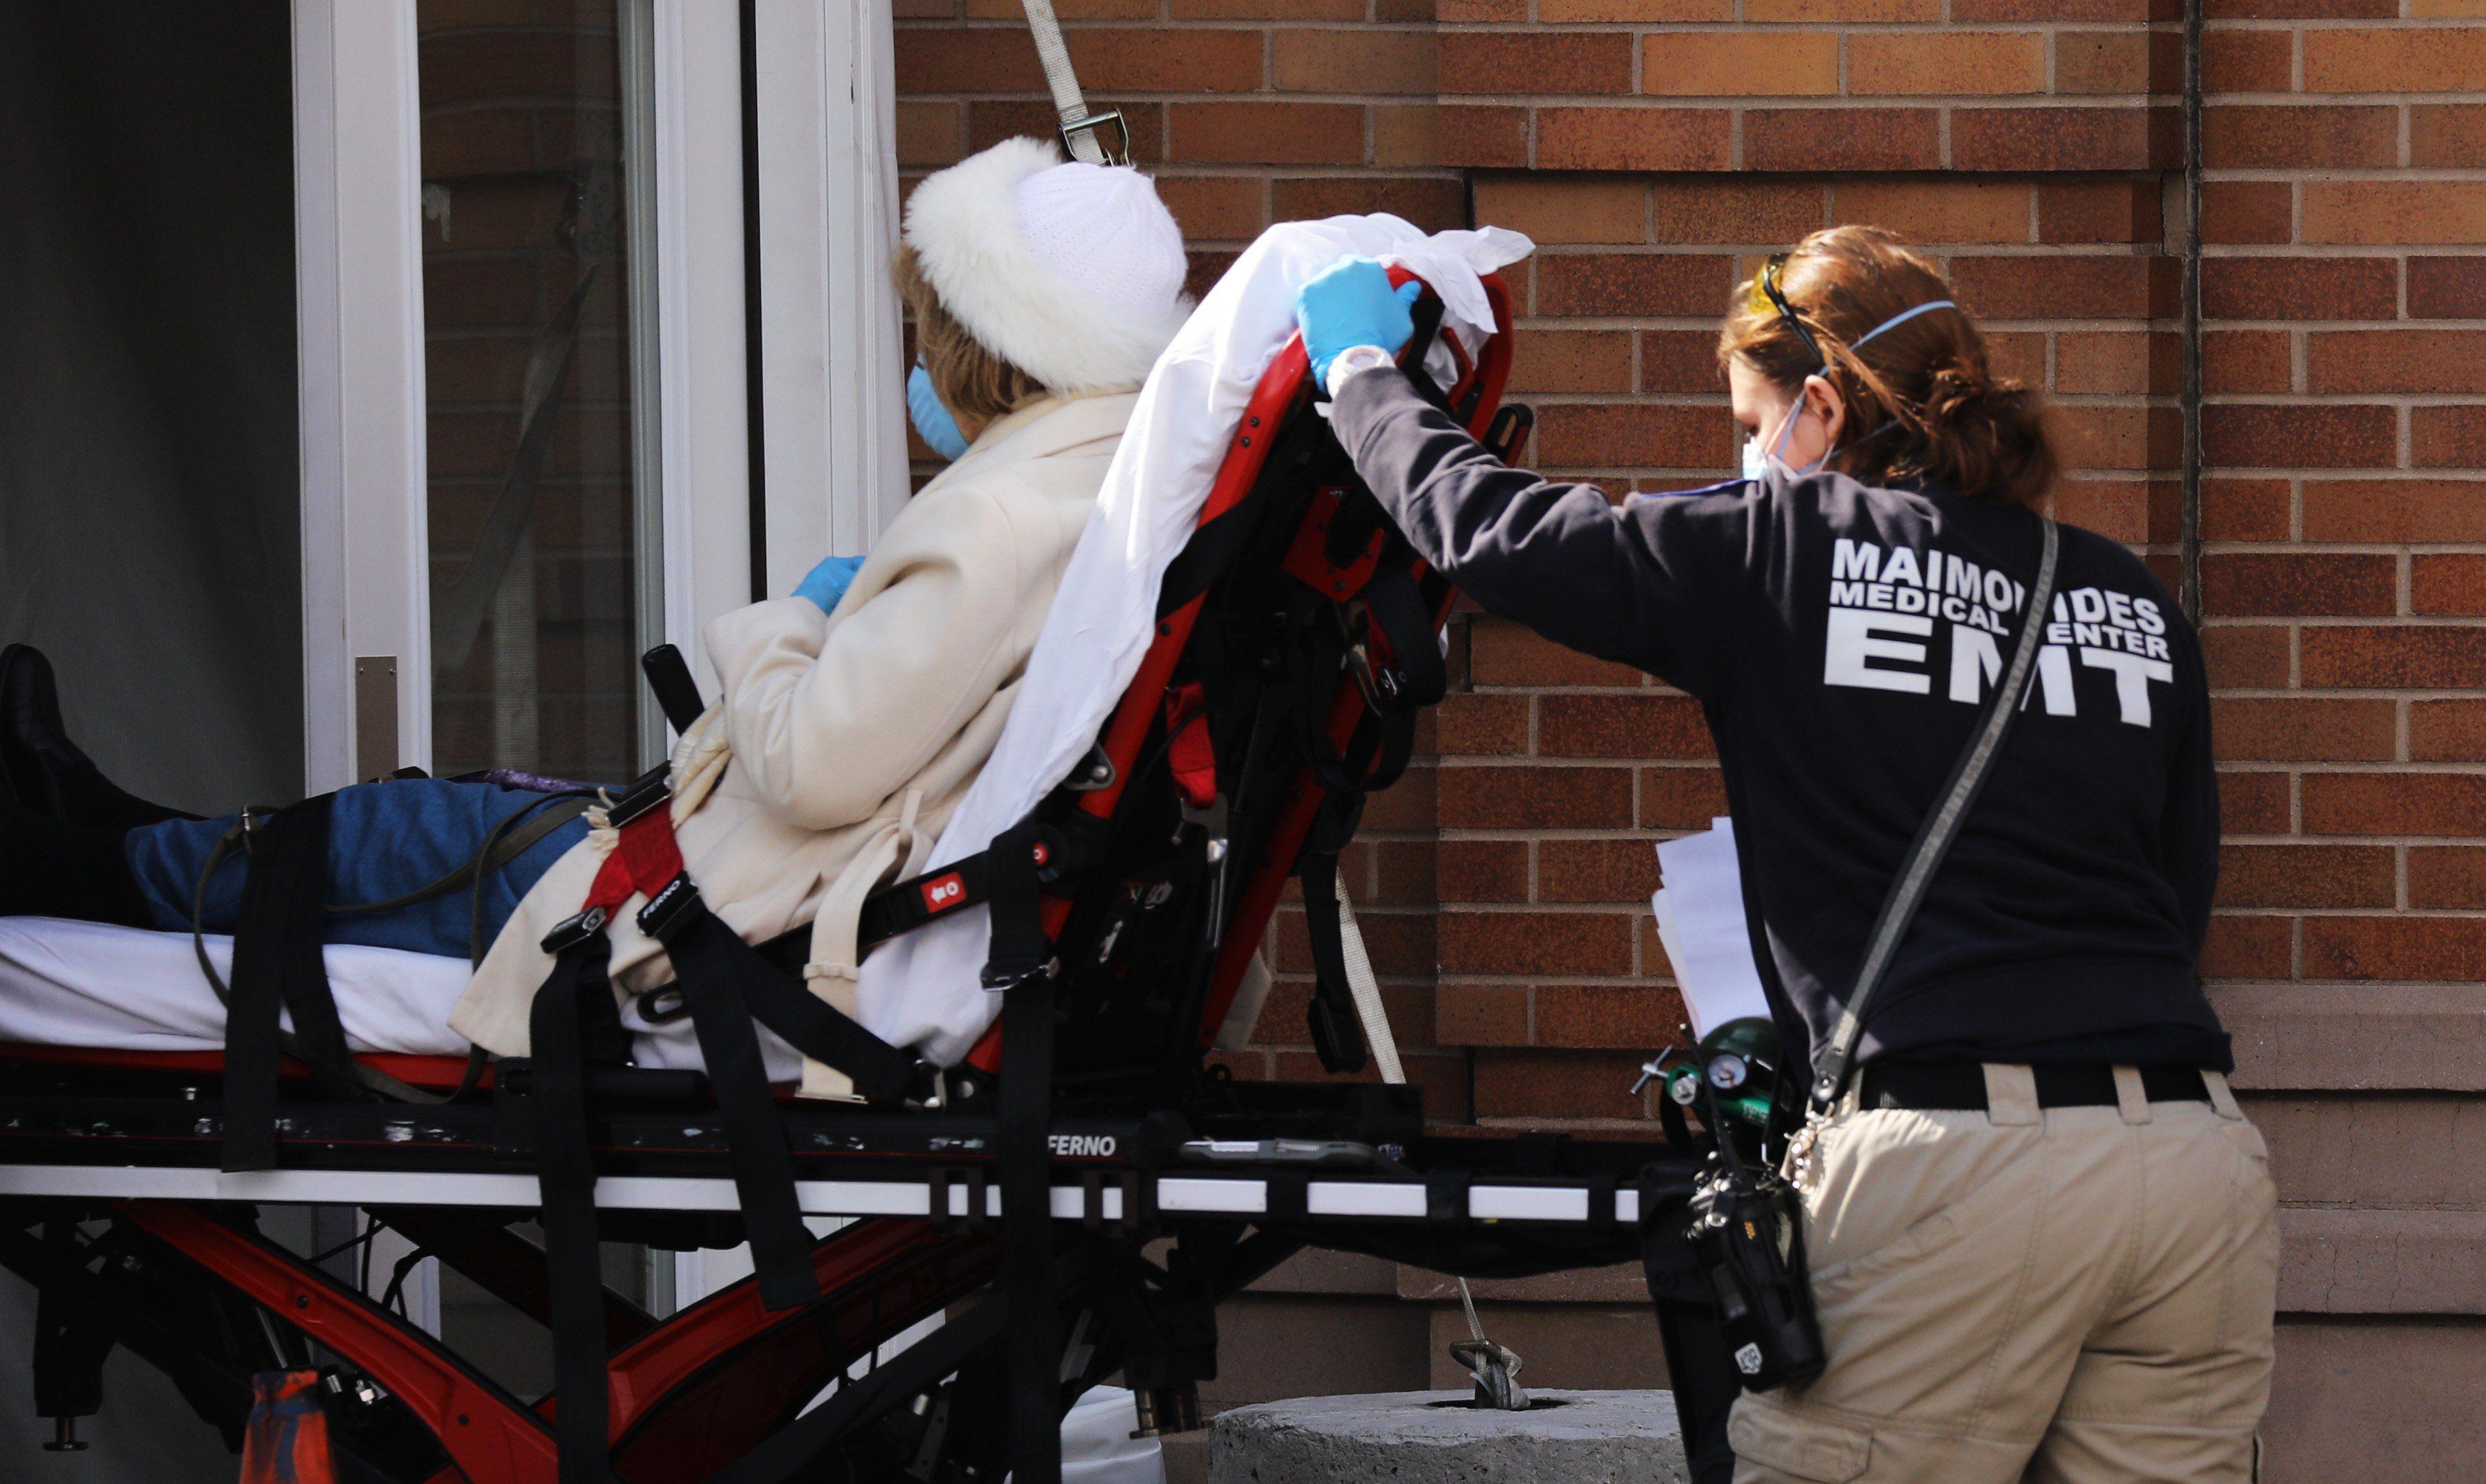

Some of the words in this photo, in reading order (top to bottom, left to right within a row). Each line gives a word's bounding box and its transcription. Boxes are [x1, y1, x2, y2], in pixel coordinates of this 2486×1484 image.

[1829, 581, 2010, 636] MEDICAL
[2046, 622, 2170, 660] ENTER
[1824, 606, 2174, 728] EMT
[643, 880, 681, 919] FERNO
[1047, 1135, 1116, 1156] FERNO
